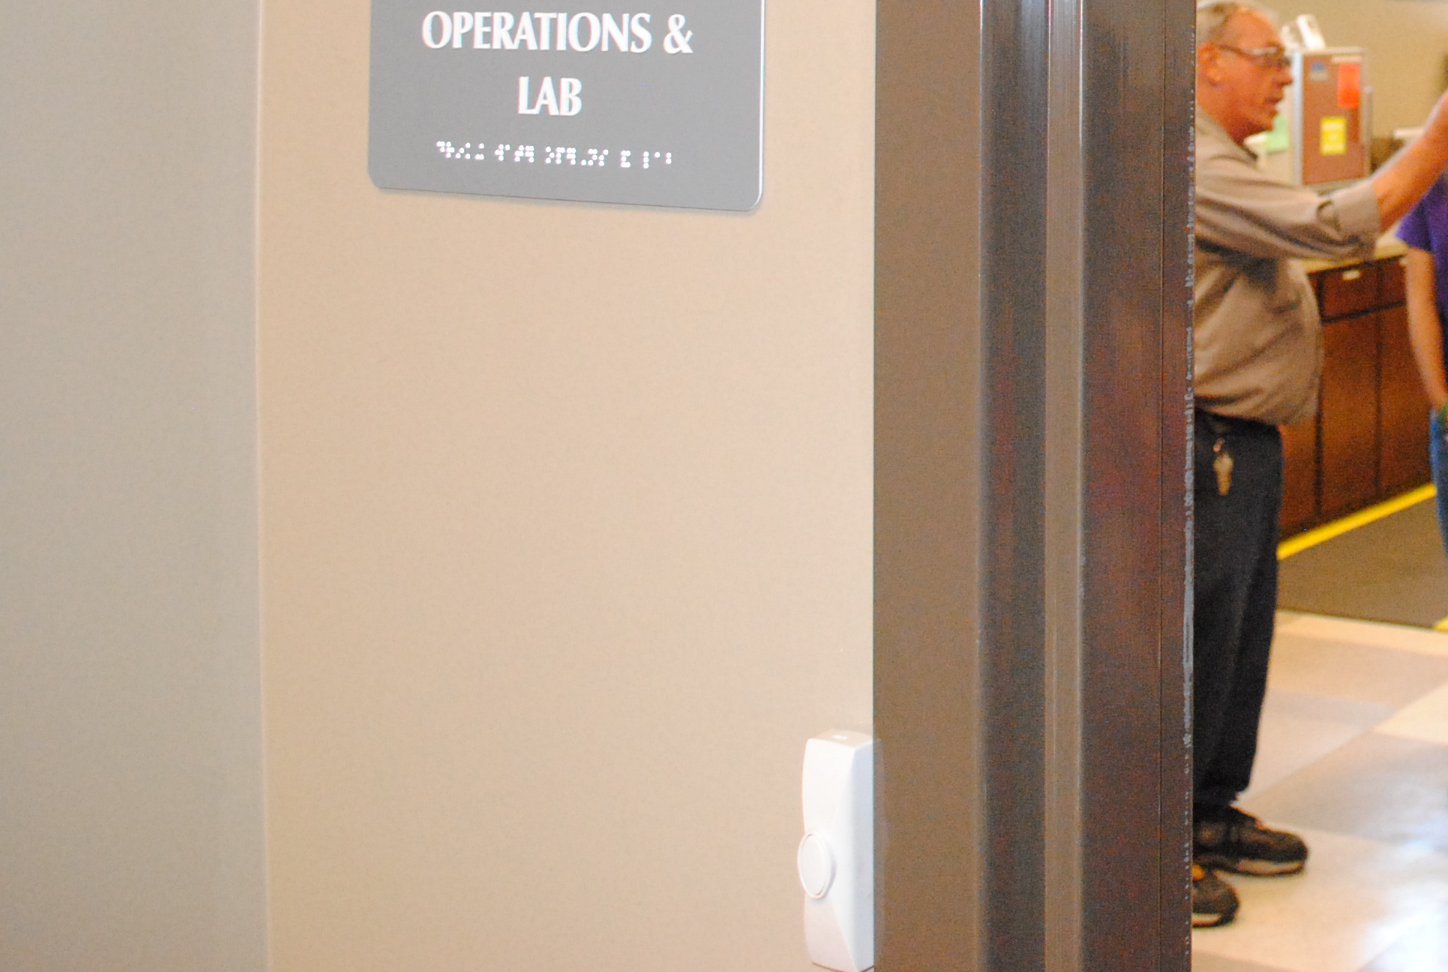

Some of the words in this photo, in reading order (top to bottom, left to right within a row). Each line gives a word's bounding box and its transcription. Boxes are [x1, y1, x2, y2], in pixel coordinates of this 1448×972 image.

[421, 10, 653, 54] OPERATIONS
[662, 13, 694, 54] &
[517, 76, 583, 117] LAB
